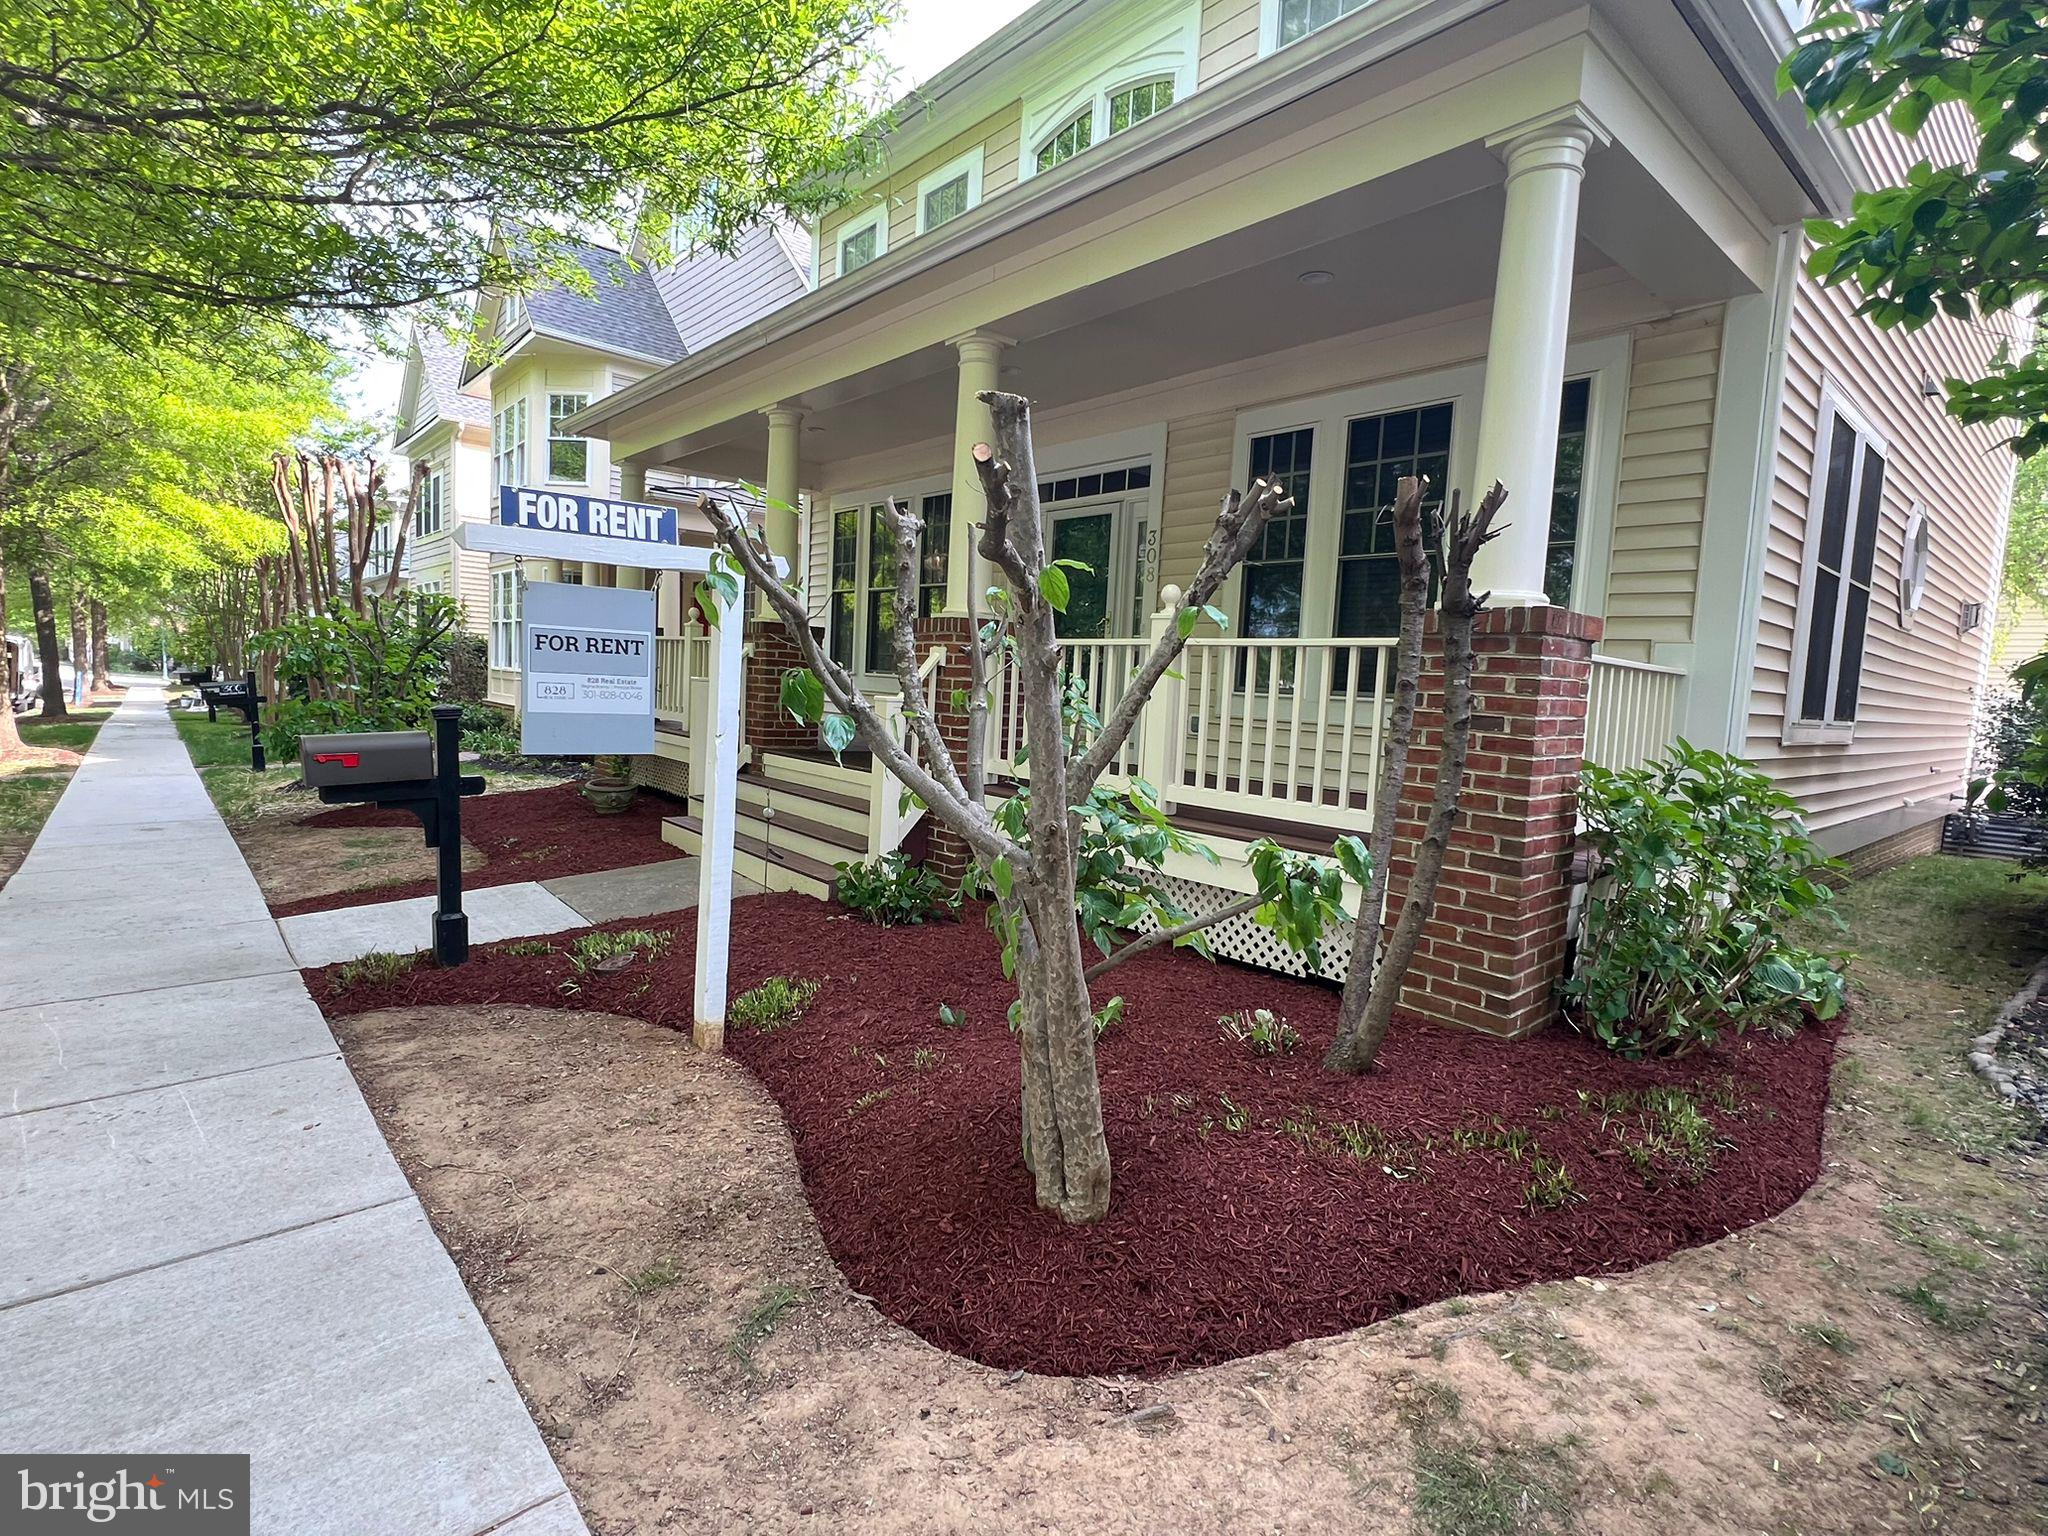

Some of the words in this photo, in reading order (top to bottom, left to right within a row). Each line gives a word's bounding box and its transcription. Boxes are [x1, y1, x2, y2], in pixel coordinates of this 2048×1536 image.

[518, 492, 579, 532] FOR
[589, 501, 663, 541] RENT
[1146, 530, 1157, 582] 308
[535, 634, 579, 652] FOR
[586, 637, 644, 655] RENT
[544, 685, 566, 695] 828
[582, 690, 643, 700] 301-828-0046
